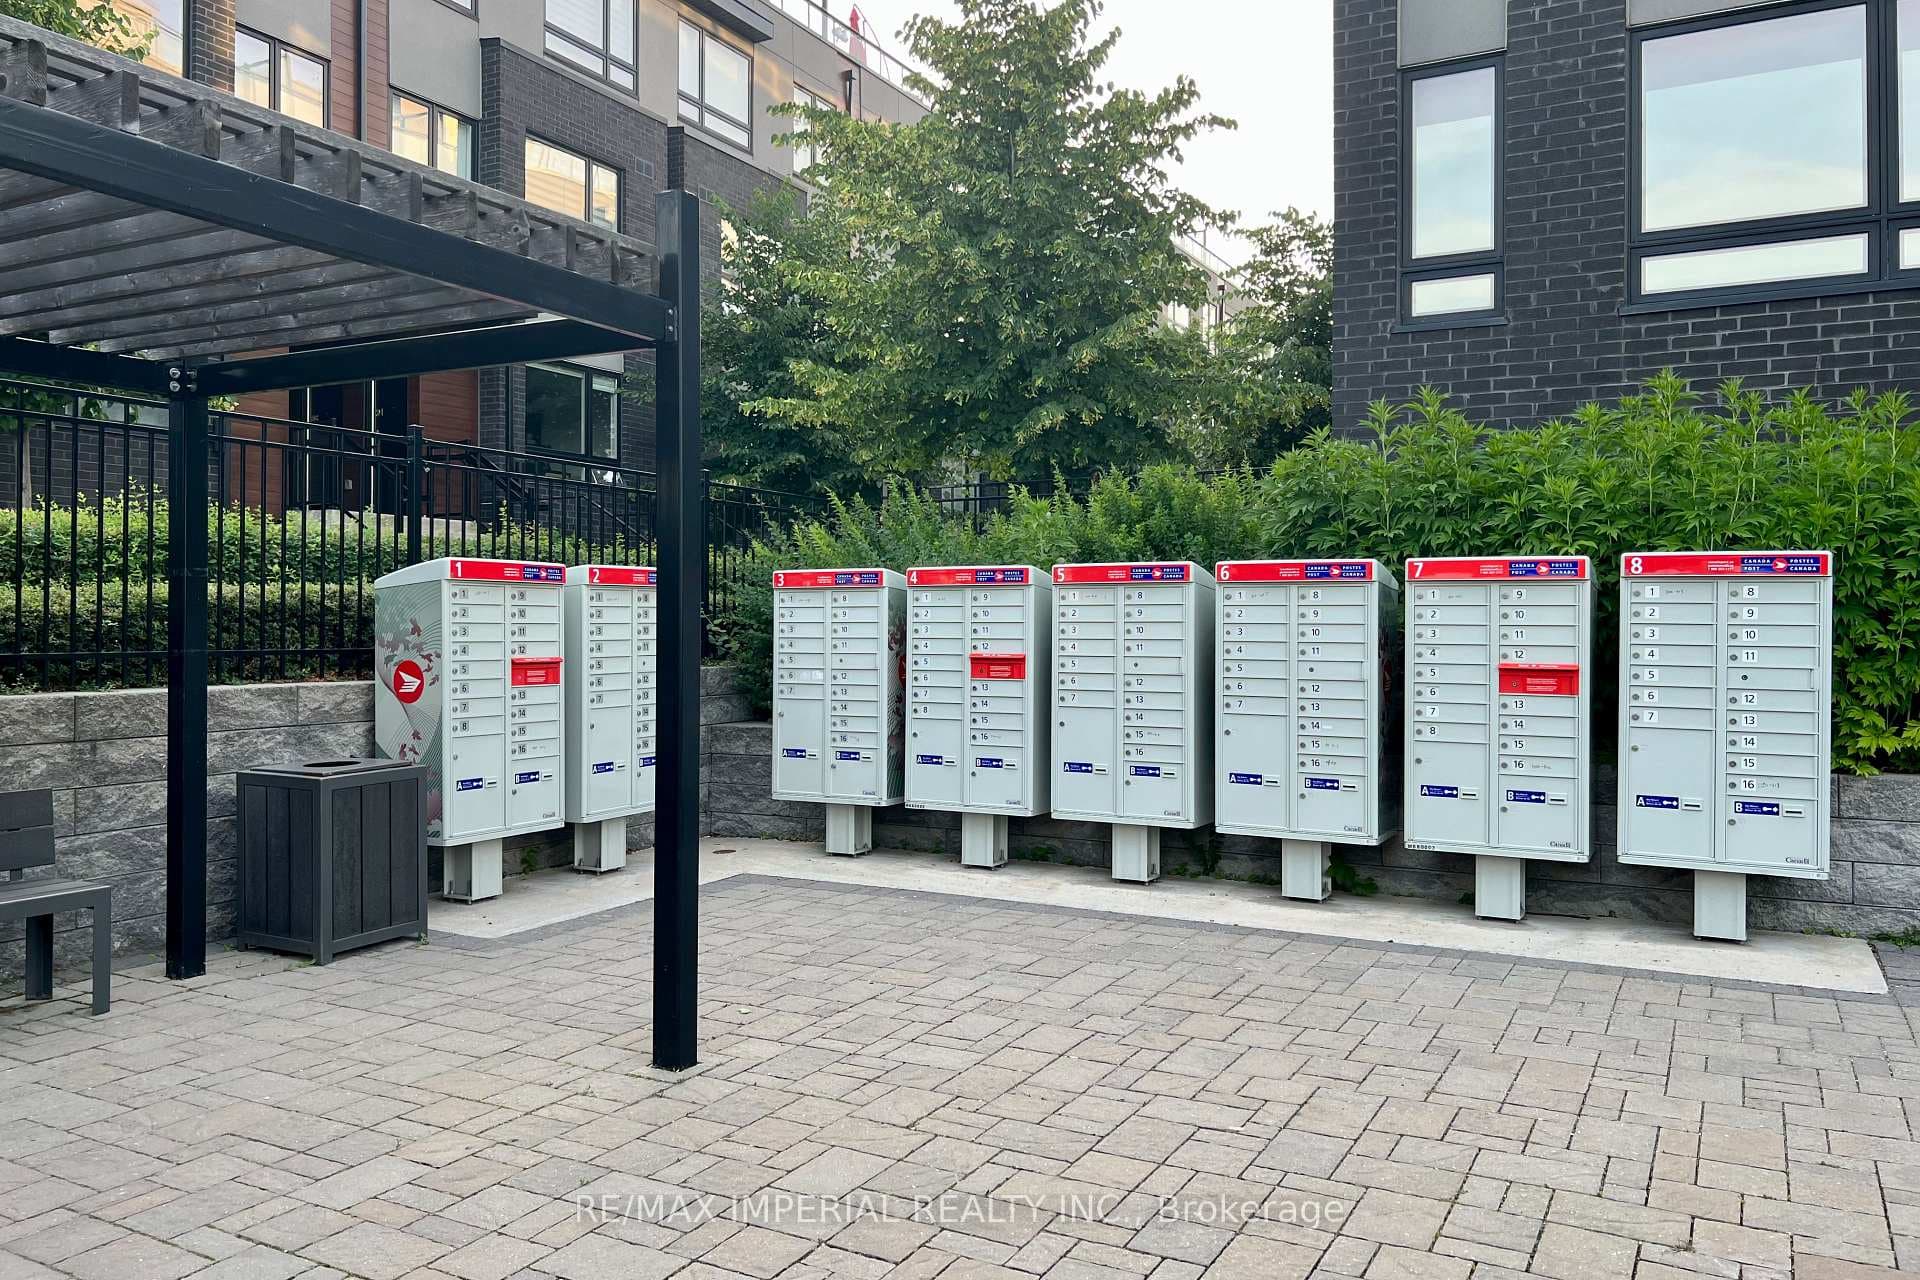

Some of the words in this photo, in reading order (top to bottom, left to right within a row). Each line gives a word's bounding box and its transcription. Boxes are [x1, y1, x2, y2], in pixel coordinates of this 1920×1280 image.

[455, 562, 462, 577] 1
[1413, 562, 1423, 578] 7
[1631, 557, 1643, 574] 8
[593, 569, 600, 583] 2
[1057, 568, 1065, 582] 5
[1220, 565, 1230, 580] 6
[777, 574, 784, 587] 3
[910, 571, 918, 584] 4
[520, 592, 525, 600] 9
[1137, 591, 1143, 599] 8
[1313, 591, 1319, 599] 8
[1432, 591, 1435, 599] 1
[1516, 590, 1523, 599] 9
[1651, 588, 1654, 596] 1
[1747, 587, 1754, 597] 8
[983, 593, 988, 601] 9
[462, 609, 466, 617] 2
[519, 609, 526, 618] 10
[1071, 609, 1077, 617] 2
[1137, 609, 1143, 617] 9
[1237, 609, 1243, 618] 2
[1313, 610, 1319, 618] 9
[1430, 610, 1436, 619] 2
[1515, 610, 1525, 619] 10
[1649, 608, 1655, 617] 2
[1747, 609, 1754, 618] 9
[462, 627, 467, 636] 3
[1136, 626, 1144, 634] 10
[1237, 627, 1243, 636] 3
[1312, 628, 1320, 636] 10
[1430, 629, 1436, 638] 3
[1515, 630, 1523, 639] 11
[1649, 629, 1655, 638] 3
[1745, 630, 1756, 639] 10
[461, 646, 466, 654] 4
[519, 646, 526, 654] 12
[1136, 643, 1143, 651] 11
[1312, 647, 1320, 655] 11
[1430, 648, 1436, 656] 4
[1515, 650, 1524, 659] 12
[1648, 650, 1655, 658] 4
[1745, 651, 1755, 660] 11
[1071, 660, 1076, 668] 5
[1237, 664, 1243, 672] 5
[462, 665, 467, 674] 5
[1430, 668, 1436, 677] 5
[1648, 670, 1655, 679] 5
[1136, 678, 1144, 686] 12
[1237, 682, 1243, 690] 6
[462, 684, 467, 693] 6
[982, 683, 989, 691] 13
[1312, 684, 1320, 693] 12
[1430, 687, 1436, 696] 6
[519, 691, 526, 699] 13
[1071, 694, 1076, 702] 7
[1136, 695, 1144, 704] 13
[1648, 691, 1655, 700] 6
[1744, 694, 1755, 704] 12
[1238, 700, 1243, 708] 7
[1311, 703, 1320, 711] 13
[1514, 700, 1524, 709] 13
[519, 709, 526, 717] 14
[923, 706, 928, 714] 8
[1430, 707, 1436, 715] 7
[981, 716, 989, 724] 15
[1648, 712, 1654, 720] 7
[1744, 716, 1755, 725] 13
[462, 722, 467, 731] 8
[1311, 721, 1320, 729] 14
[1514, 720, 1524, 729] 14
[519, 727, 526, 735] 15
[1136, 730, 1144, 738] 15
[1429, 726, 1436, 735] 8
[1311, 740, 1320, 748] 15
[1514, 740, 1524, 749] 15
[1744, 737, 1755, 746] 14
[519, 745, 526, 753] 16
[1135, 748, 1144, 756] 16
[917, 755, 923, 763] A
[1311, 759, 1320, 767] 16
[1744, 758, 1755, 768] 15
[1064, 763, 1070, 771] A
[1514, 760, 1524, 769] 16
[1131, 767, 1136, 775] B
[1230, 774, 1237, 783] A
[1306, 779, 1311, 787] B
[1743, 780, 1755, 789] 16
[1422, 786, 1429, 795] A
[1508, 791, 1514, 800] B
[1637, 797, 1645, 806] A
[1736, 803, 1743, 812] B
